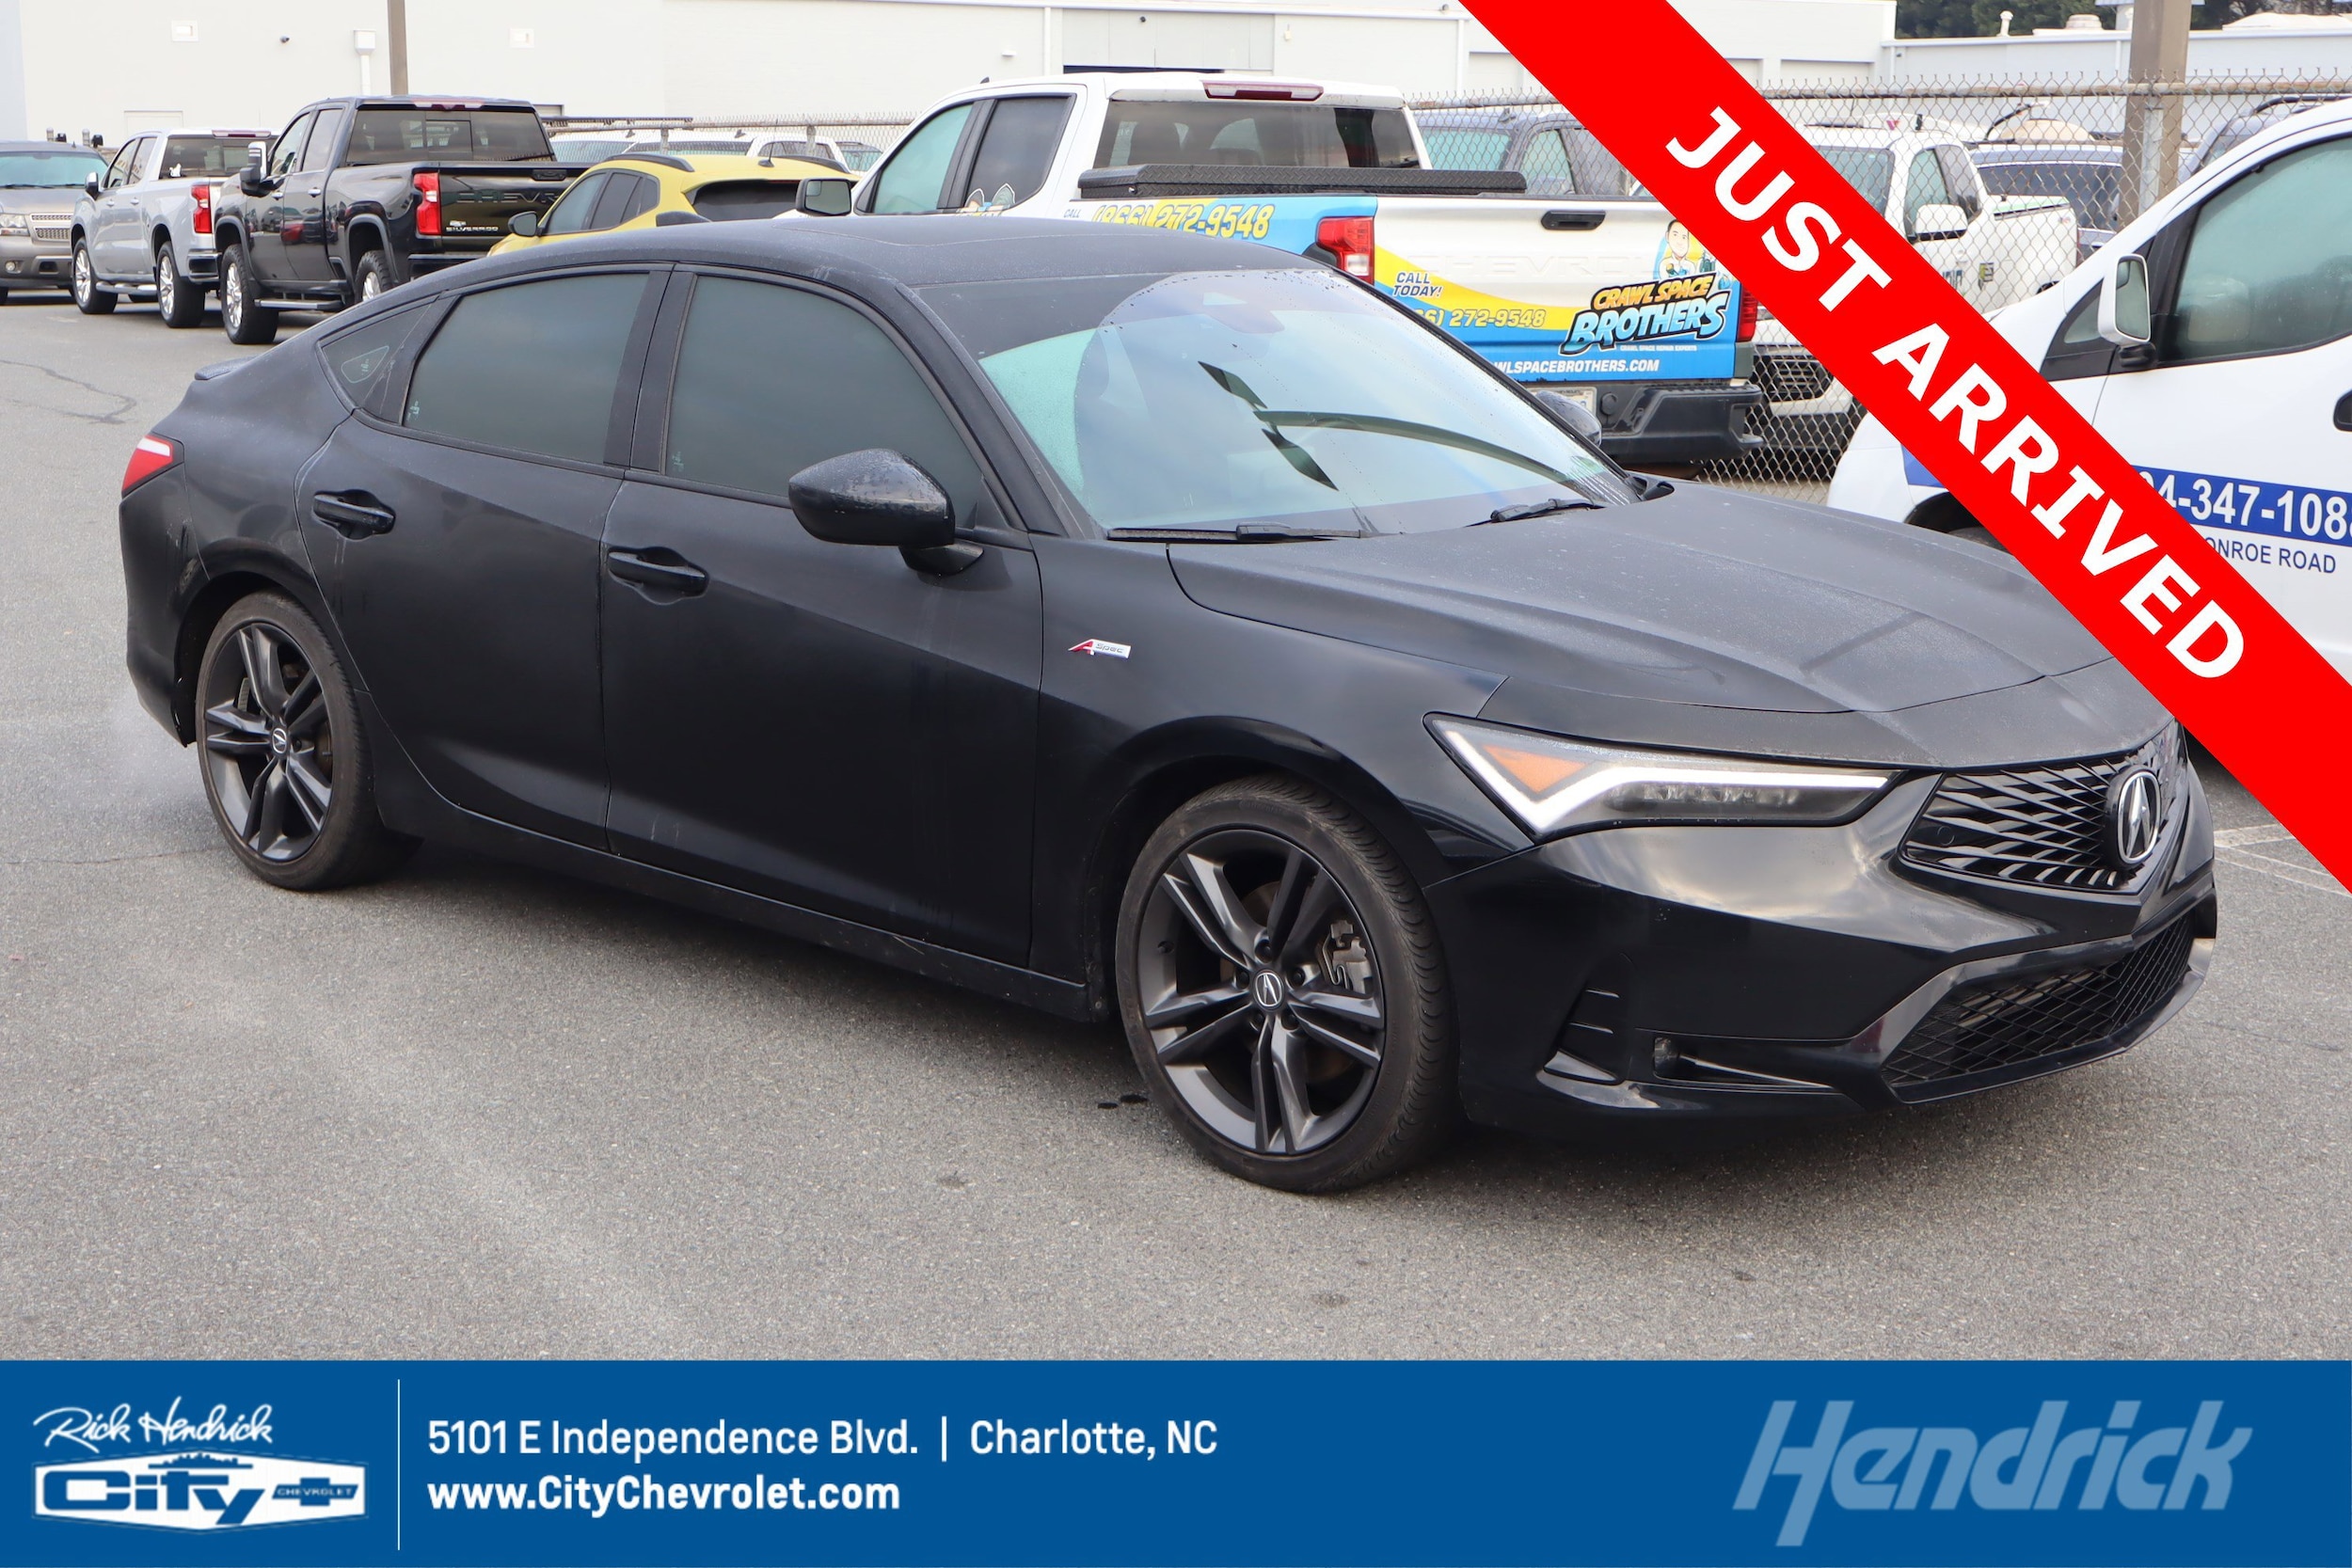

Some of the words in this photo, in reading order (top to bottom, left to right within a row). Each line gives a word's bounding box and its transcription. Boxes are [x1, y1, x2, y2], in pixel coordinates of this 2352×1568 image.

[1063, 209, 1081, 218] CALL
[1152, 204, 1275, 239] 272-9548
[1396, 272, 1431, 284] CALL
[1393, 285, 1442, 297] TODAY!
[1593, 283, 1654, 310] CRAWL
[1657, 276, 1715, 304] SPACE
[1449, 309, 1547, 328] 272-9548
[1559, 293, 1731, 356] BROTHERS
[2278, 547, 2337, 574] ROAD
